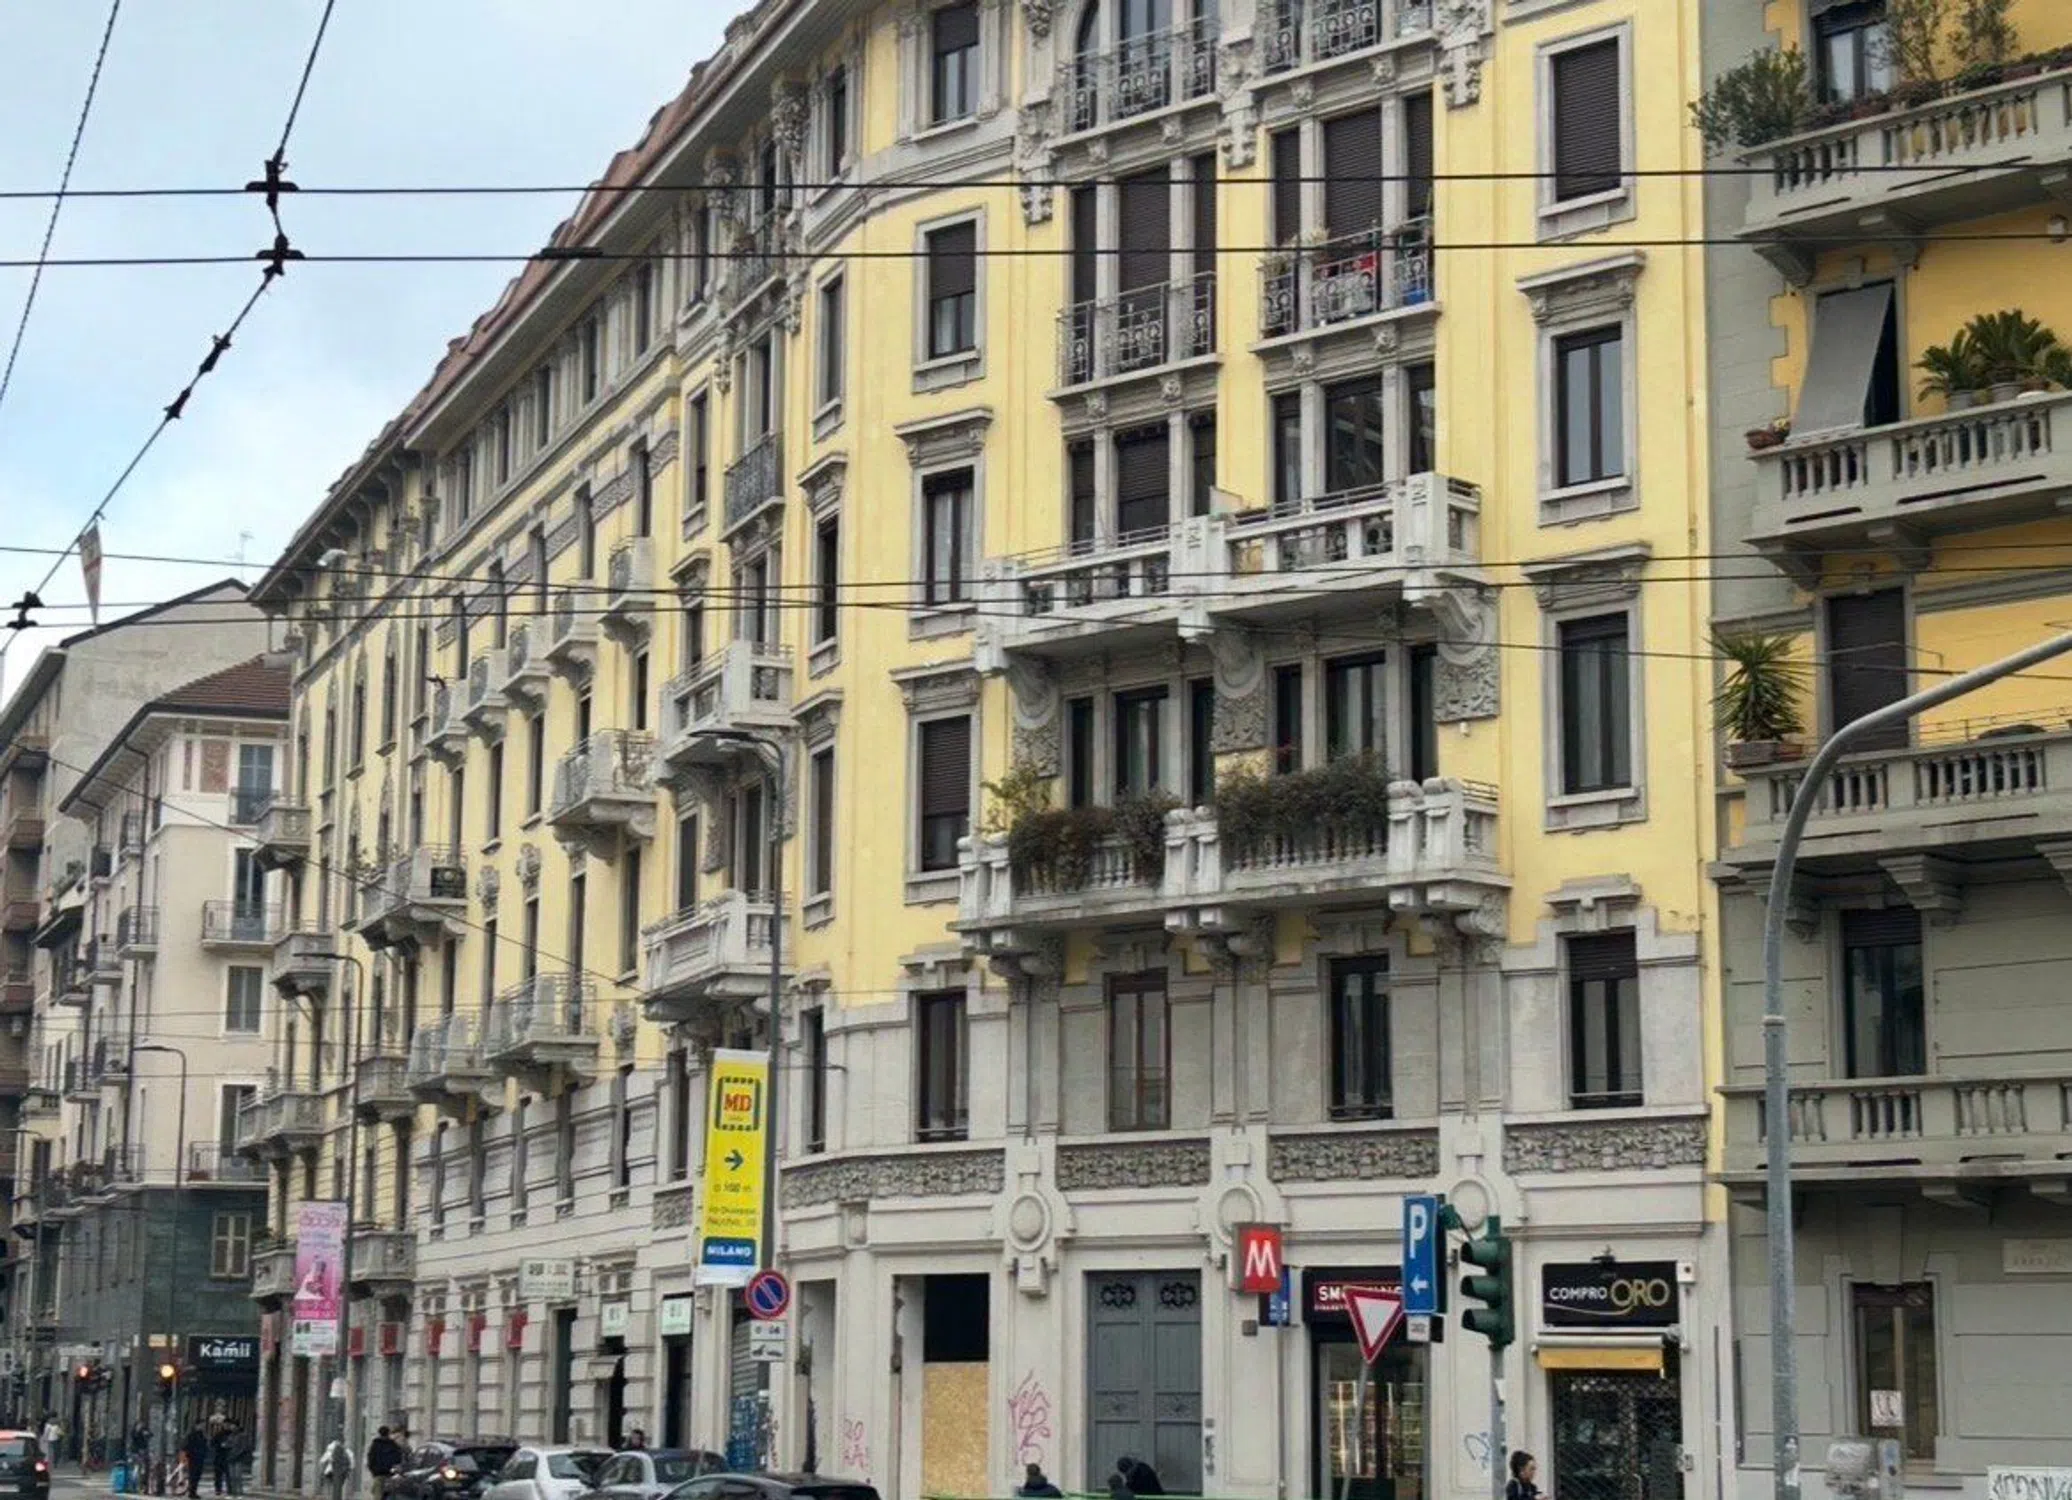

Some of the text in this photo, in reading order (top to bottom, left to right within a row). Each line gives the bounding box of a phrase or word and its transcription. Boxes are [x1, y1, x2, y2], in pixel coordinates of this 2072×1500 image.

[725, 1094, 752, 1111] MD
[1409, 1204, 1428, 1259] P
[707, 1245, 752, 1257] MILANO
[1245, 1239, 1277, 1277] M
[1549, 1279, 1669, 1306] COMPRO ORO
